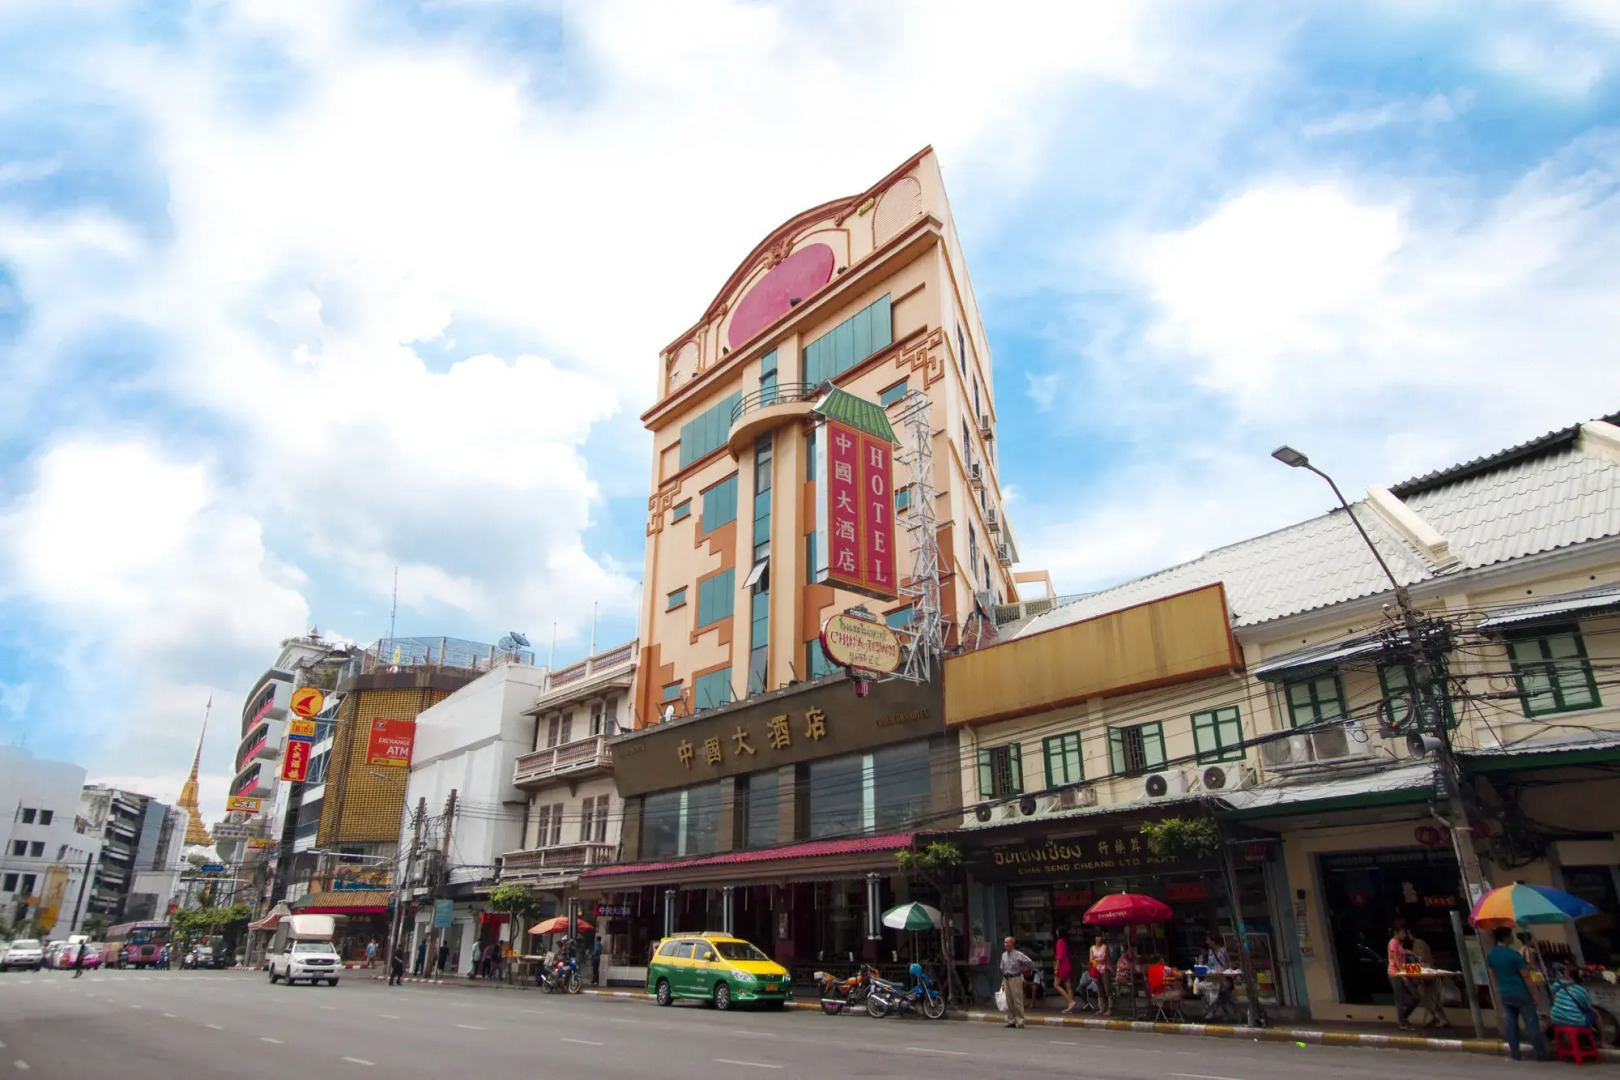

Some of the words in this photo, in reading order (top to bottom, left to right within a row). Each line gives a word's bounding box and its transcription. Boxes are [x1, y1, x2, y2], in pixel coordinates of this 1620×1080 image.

[834, 432, 856, 573] 中國大酒店
[869, 445, 887, 583] HOTEL
[830, 630, 863, 649] CHINA
[867, 639, 896, 657] TOWN
[378, 737, 411, 746] EXCHANGE
[386, 745, 409, 756] ATM
[676, 705, 828, 769] 中國大酒店
[1044, 863, 1070, 873] SENG
